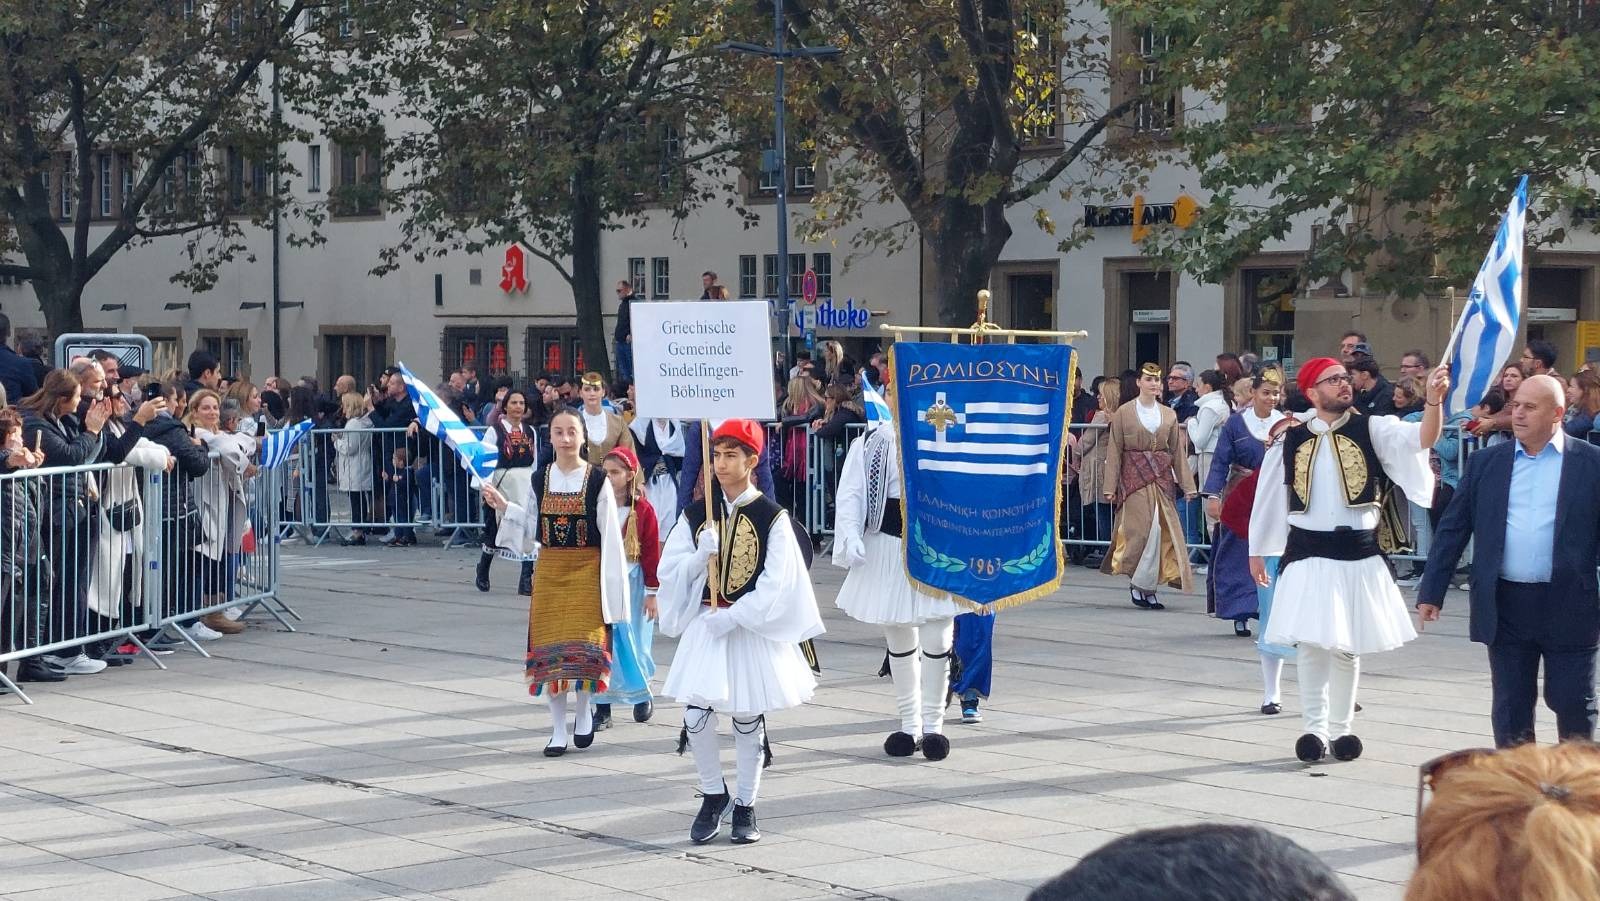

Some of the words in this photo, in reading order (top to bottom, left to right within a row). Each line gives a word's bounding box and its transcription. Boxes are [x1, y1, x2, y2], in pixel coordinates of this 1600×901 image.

[661, 319, 736, 335] Griechische
[668, 341, 732, 356] Gemeinde
[659, 362, 744, 380] Sindelfingen-
[908, 360, 1060, 386] ΡΩΜΙΟΣΥΝΗ
[670, 384, 735, 401] Böblingen
[917, 491, 977, 518] ΕΛΛΗΝΙΚΗ
[982, 496, 1047, 519] ΚΟΙΝΟΤΗΤΑ
[969, 557, 1001, 576] 1963
